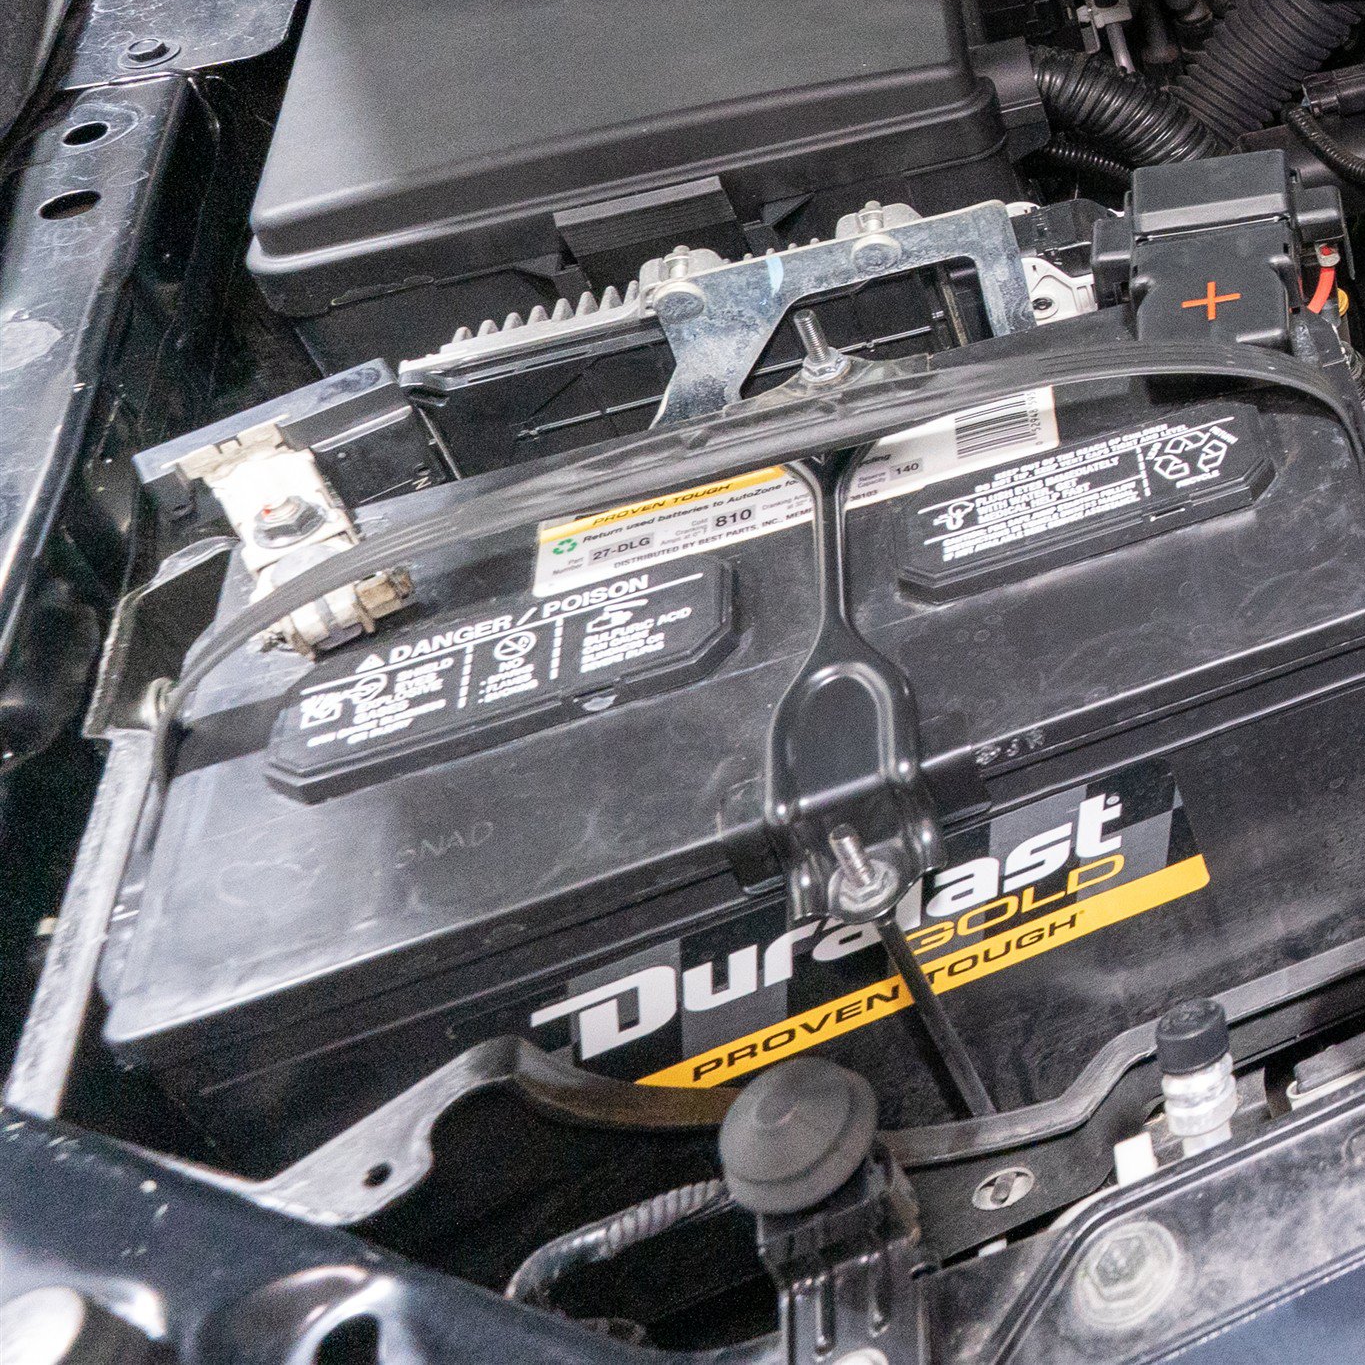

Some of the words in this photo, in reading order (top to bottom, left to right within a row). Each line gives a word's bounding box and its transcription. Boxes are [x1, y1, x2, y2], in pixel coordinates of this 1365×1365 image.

[896, 462, 919, 475] 140
[974, 488, 1014, 508] FLUSH
[1014, 479, 1044, 496] EYES
[1044, 456, 1121, 487] IMMEDIATELY
[583, 526, 623, 543] Return
[626, 517, 655, 531] used
[658, 504, 709, 522] batteries
[713, 499, 724, 509] to
[727, 484, 782, 504] AutoZone
[593, 500, 666, 526] PROVEN
[673, 483, 731, 504] TOUGH
[715, 508, 752, 527] 810
[976, 499, 1009, 517] WITH
[1054, 477, 1080, 492] GET
[977, 502, 1031, 525] MEDICAL
[1030, 490, 1061, 508] HELP
[1061, 481, 1091, 499] FAST
[593, 536, 650, 561] 27-DLG
[613, 545, 679, 568] DISTRIBUTED
[682, 541, 695, 551] BY
[698, 534, 723, 546] BEST
[389, 614, 514, 664] DANGER
[542, 574, 650, 619] POISON
[582, 618, 655, 648] SULFURIC
[656, 606, 693, 627] ACID
[498, 656, 526, 674] NO
[906, 854, 1124, 956] GOLD
[691, 984, 900, 1082] PROVEN
[926, 913, 1077, 983] TOUGH
